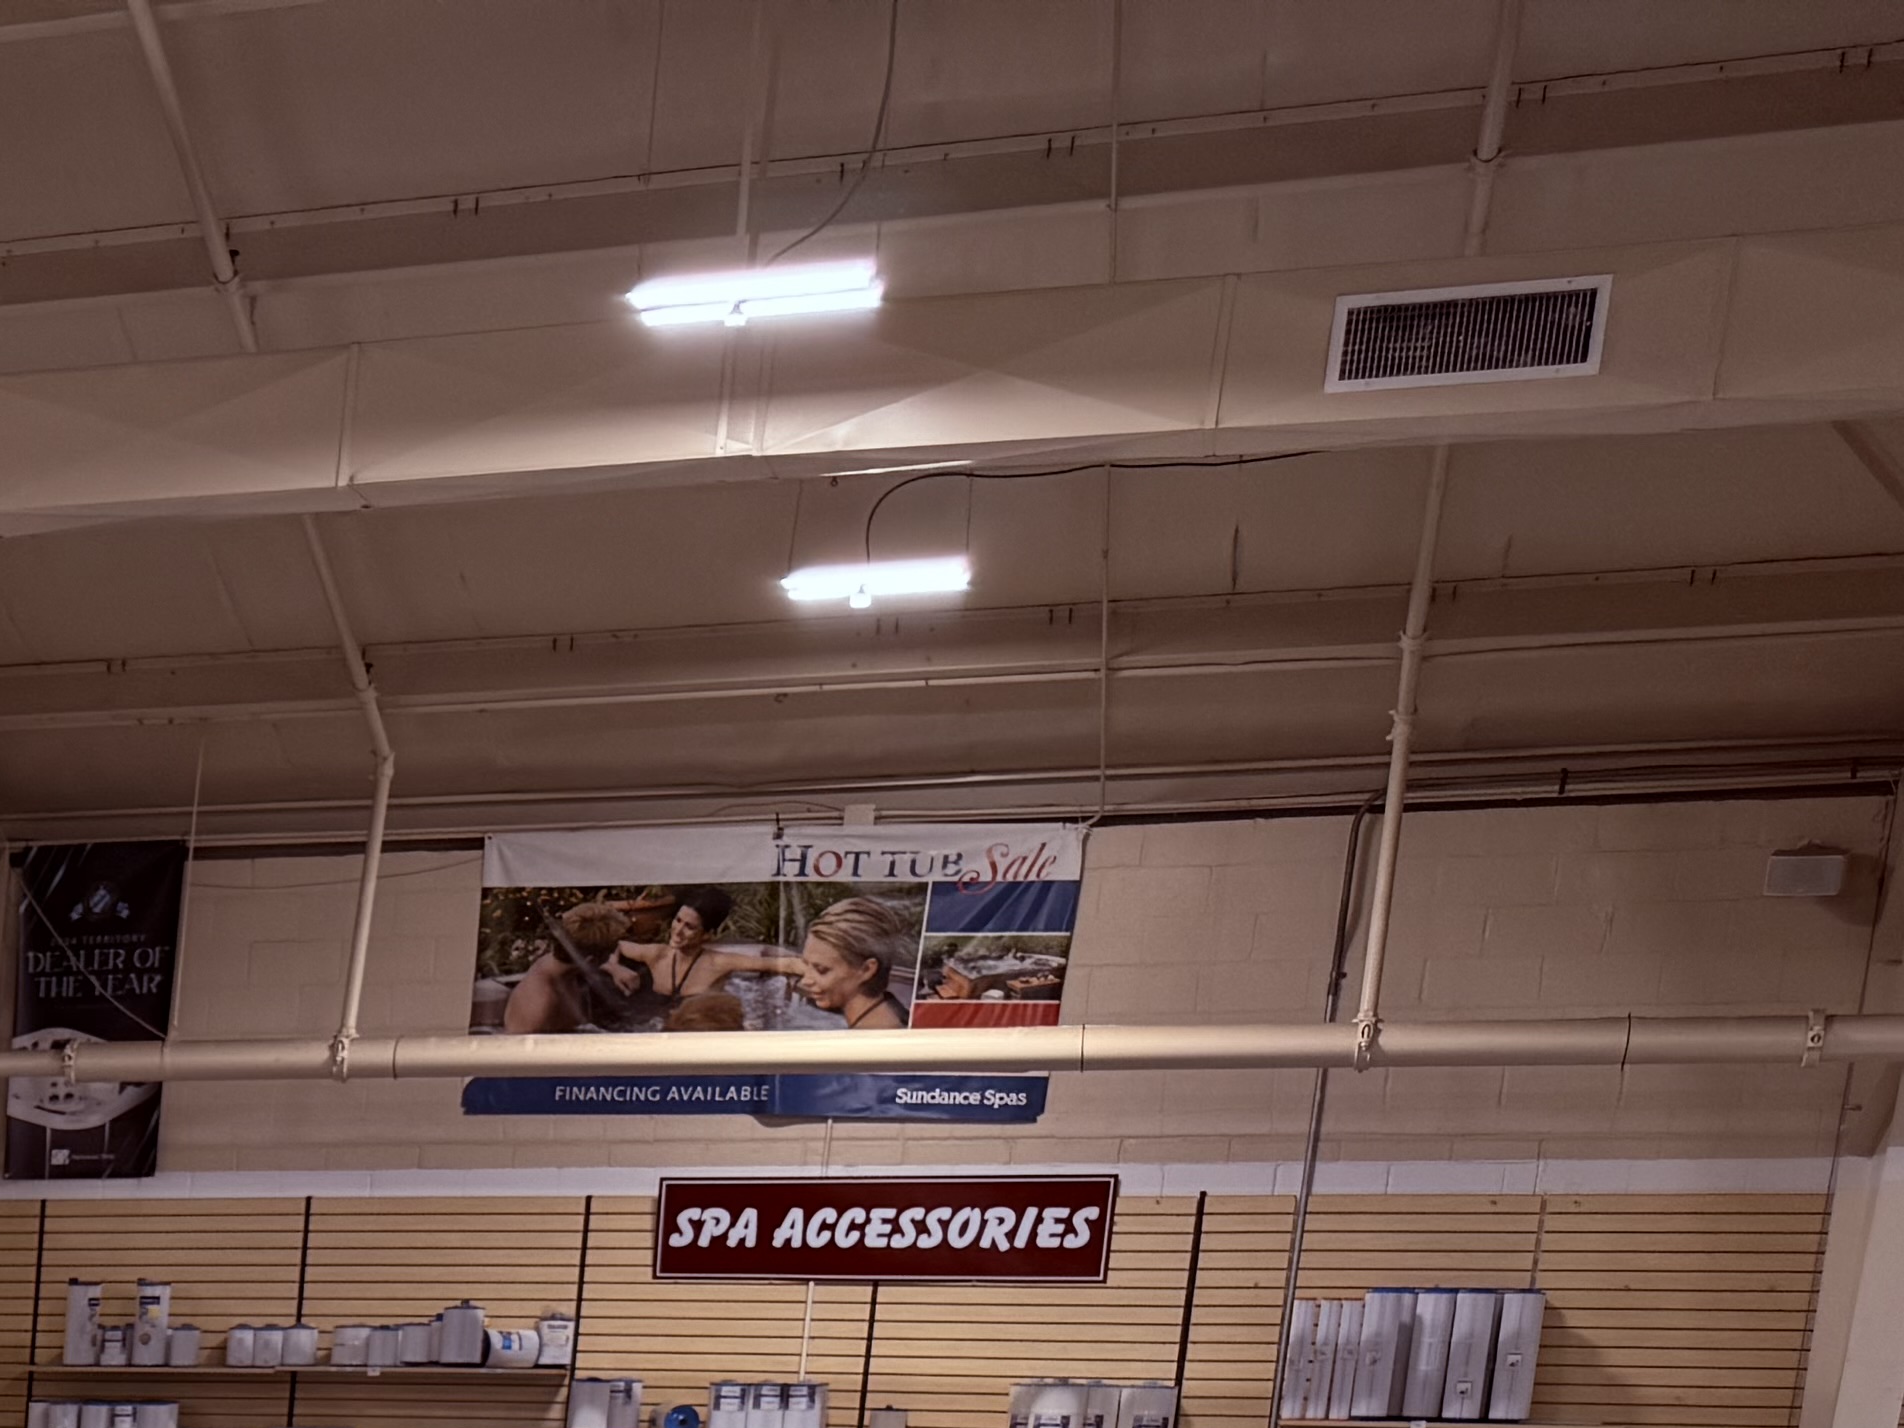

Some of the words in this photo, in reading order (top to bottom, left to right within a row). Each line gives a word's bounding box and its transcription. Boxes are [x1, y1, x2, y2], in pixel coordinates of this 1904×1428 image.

[771, 843, 871, 878] HOT
[880, 850, 965, 878] TUB
[957, 842, 1058, 895] Sale
[26, 948, 126, 974] DEALER
[34, 975, 84, 998] THE
[555, 1085, 661, 1102] FINANCING
[667, 1084, 770, 1102] AVAILABLE
[895, 1086, 981, 1106] Sundance
[983, 1088, 1028, 1108] Spas
[669, 1207, 759, 1249] SPA
[772, 1205, 1100, 1252] ACCESSORIES
